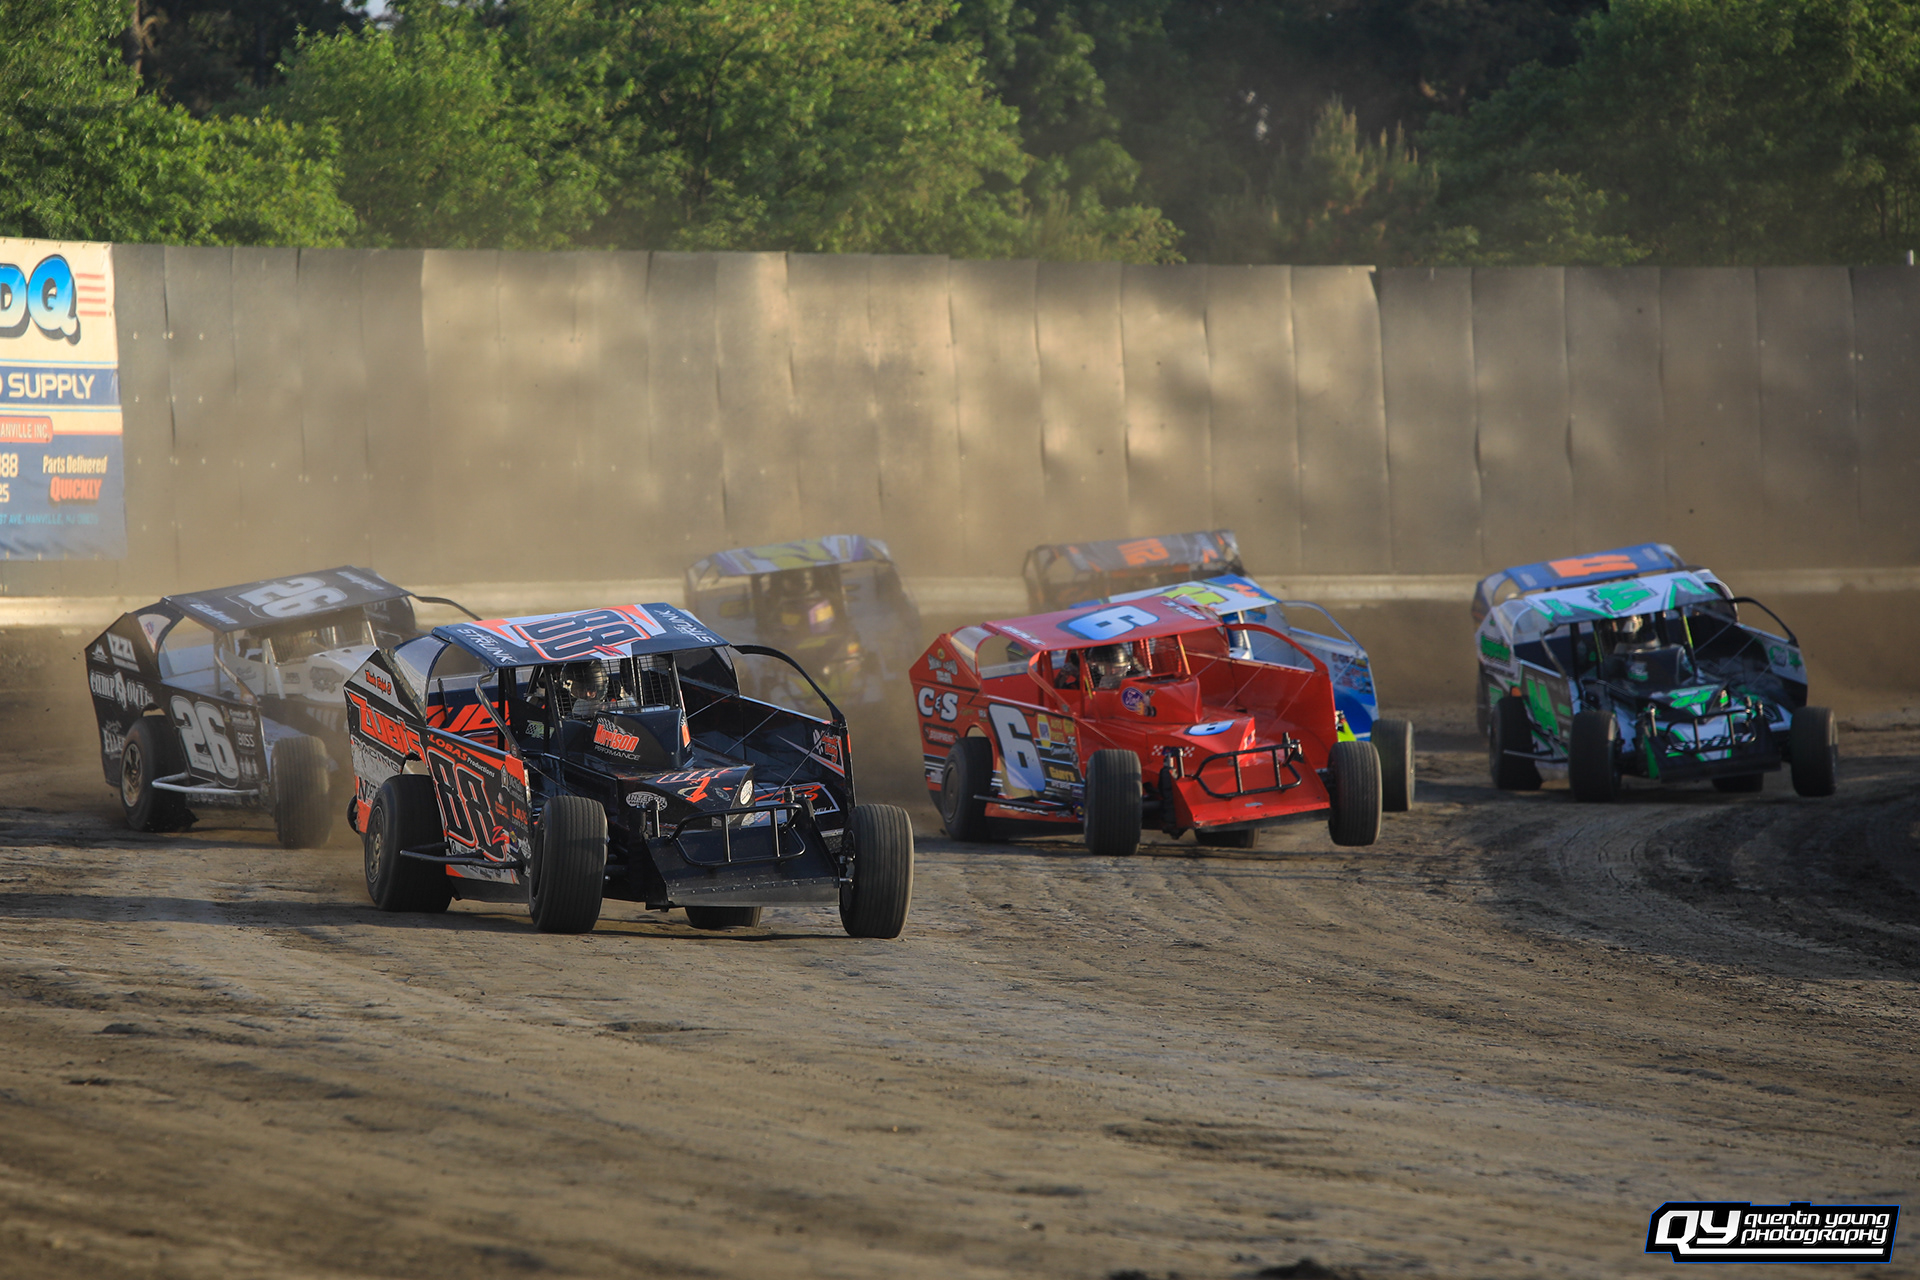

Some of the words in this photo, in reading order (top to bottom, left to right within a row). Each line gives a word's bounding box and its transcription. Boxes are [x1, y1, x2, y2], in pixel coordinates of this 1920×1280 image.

[8, 373, 96, 399] SUPPLY
[0, 453, 18, 478] 88
[42, 454, 65, 474] Parts
[66, 454, 108, 474] Delivered
[237, 577, 347, 618] 26
[511, 608, 651, 661] 88
[1067, 605, 1159, 640] 6
[918, 686, 959, 722] C&S
[170, 696, 240, 786] 26
[428, 734, 468, 761] LOBAS
[594, 723, 640, 753] Morrison
[594, 745, 641, 761] PERFORMANCE
[988, 702, 1046, 792] 6
[467, 757, 495, 778] Productions
